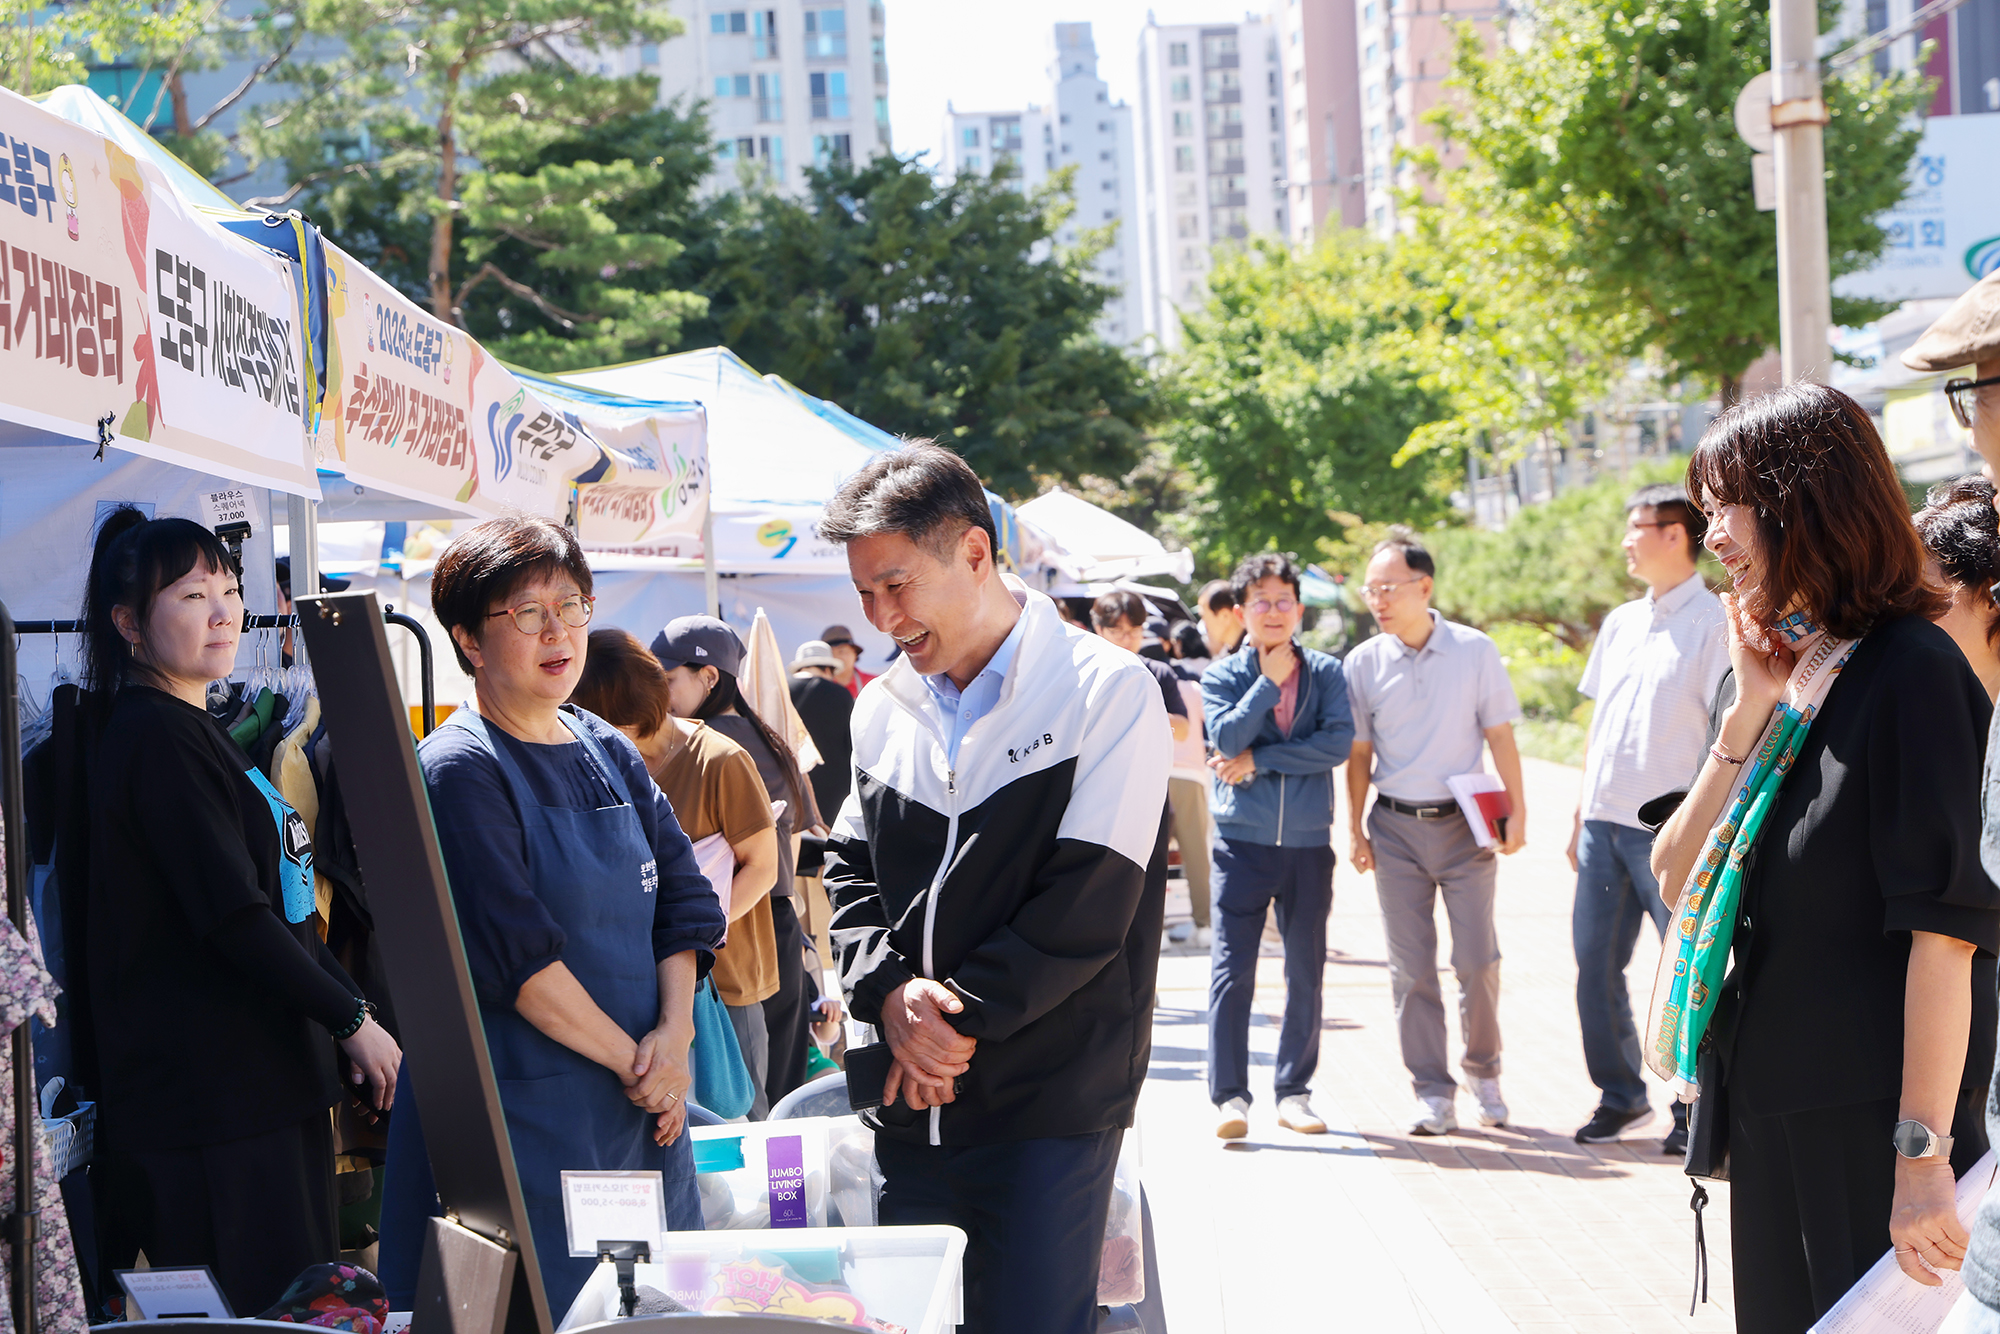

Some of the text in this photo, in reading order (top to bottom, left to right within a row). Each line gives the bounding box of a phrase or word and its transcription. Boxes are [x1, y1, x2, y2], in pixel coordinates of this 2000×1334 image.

[156, 248, 300, 417] 도봉구 사회적경제기업
[377, 303, 443, 376] 2026년 도봉구
[345, 361, 468, 471] 추석맞이 직거래장터
[517, 411, 576, 461] 무주군
[210, 490, 243, 503] 블라우스
[769, 1166, 803, 1178] JUMBO
[770, 1178, 802, 1190] LIVING
[778, 1190, 798, 1201] BOX
